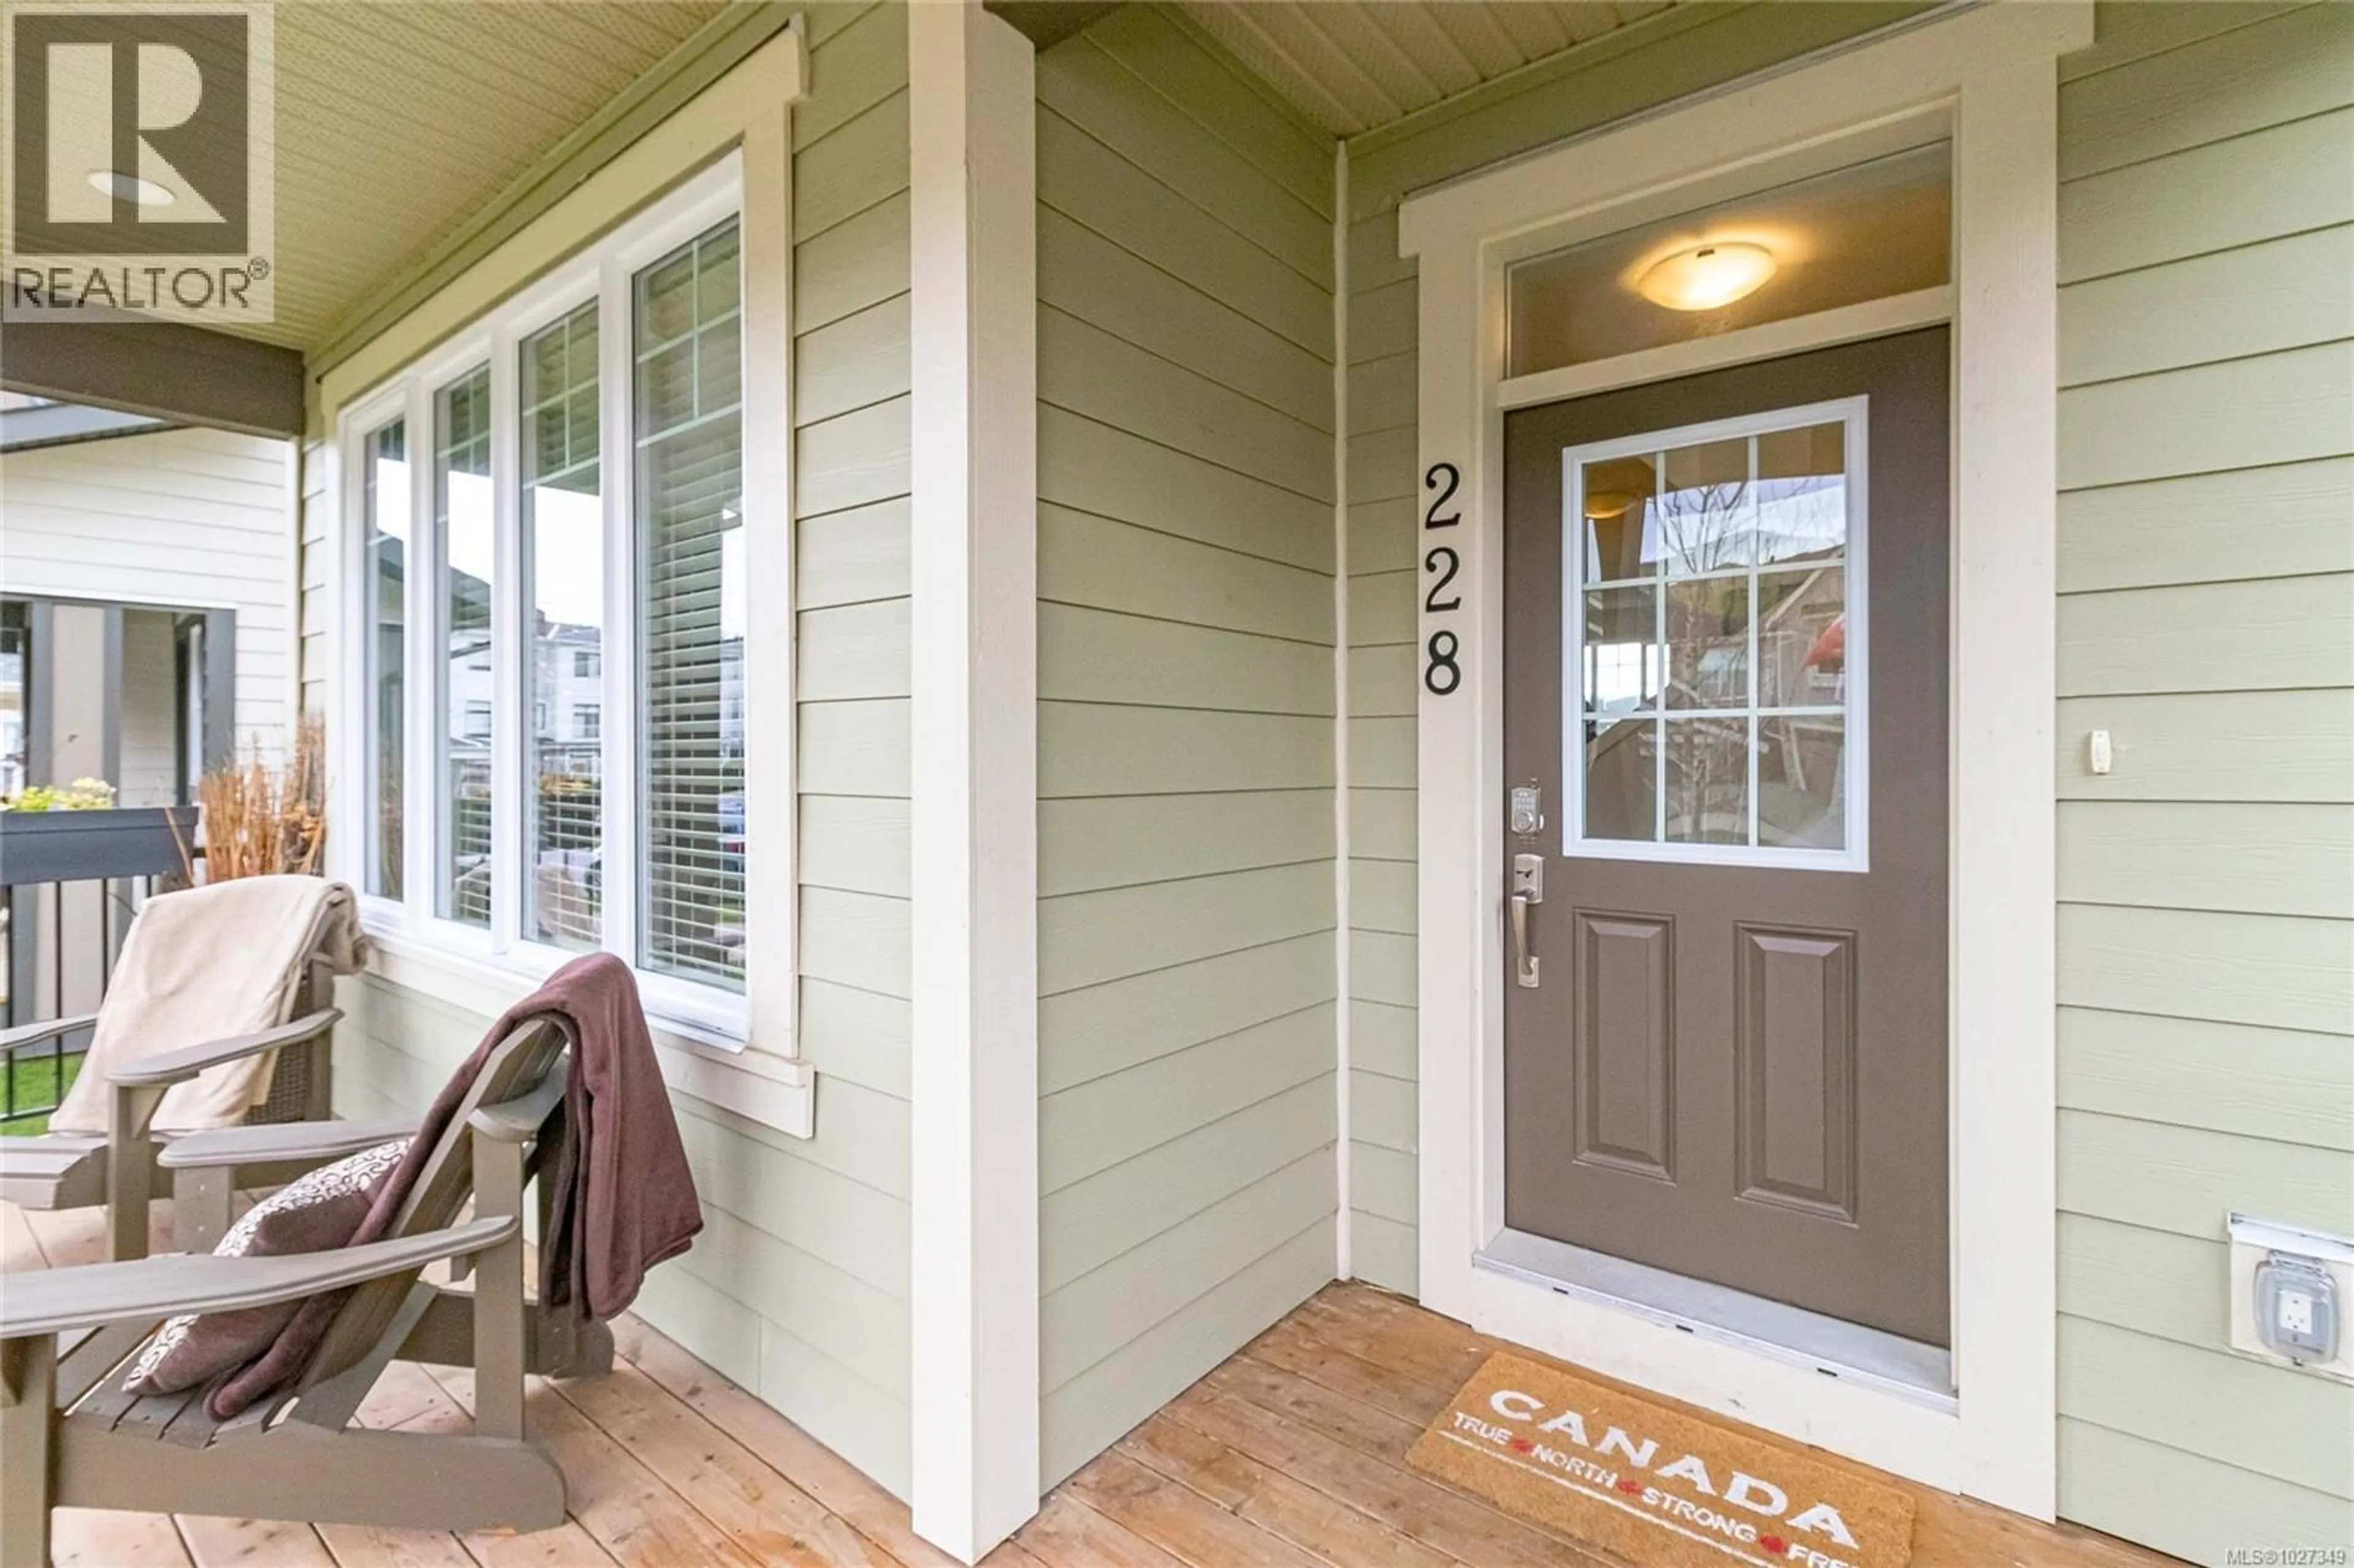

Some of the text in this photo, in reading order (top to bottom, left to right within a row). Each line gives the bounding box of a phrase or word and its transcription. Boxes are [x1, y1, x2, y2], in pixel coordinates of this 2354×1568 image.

[1425, 463, 1461, 696] 228
[1453, 1412, 1860, 1568] TRUE NORTH STRONG FR
[1490, 1390, 1859, 1549] CANADA
